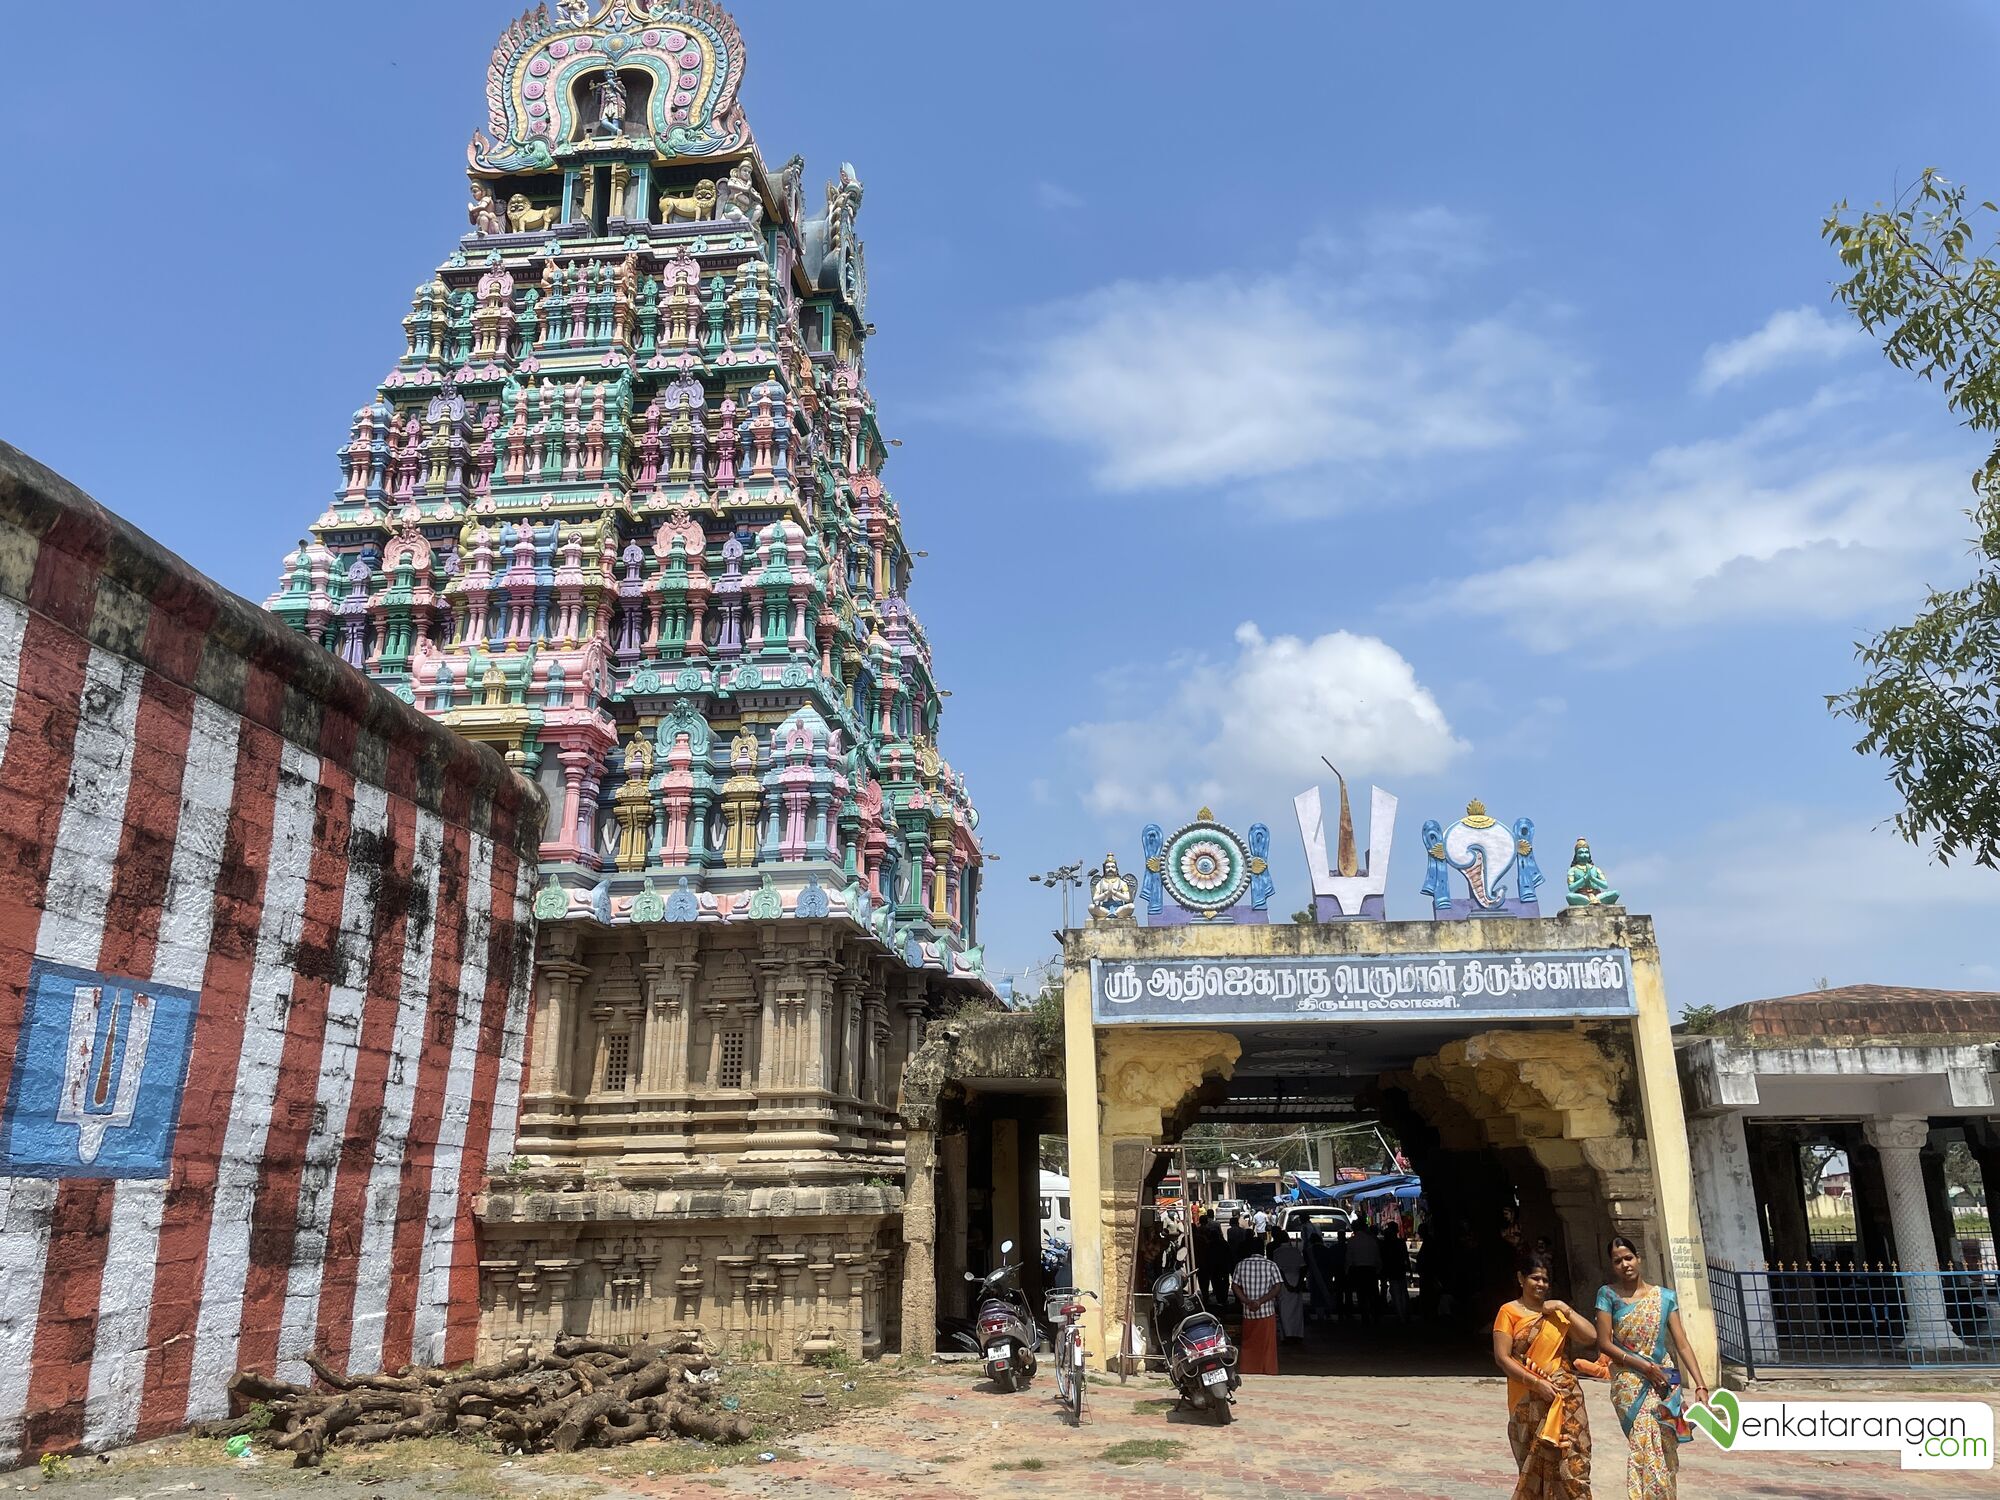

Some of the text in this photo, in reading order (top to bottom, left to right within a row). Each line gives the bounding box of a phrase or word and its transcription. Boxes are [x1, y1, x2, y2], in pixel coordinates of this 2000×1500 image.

[1104, 965, 1142, 1003] ஸ்ரீ
[1334, 959, 1456, 998] பெருமாள்
[1461, 955, 1623, 998] திருக்கோயில்
